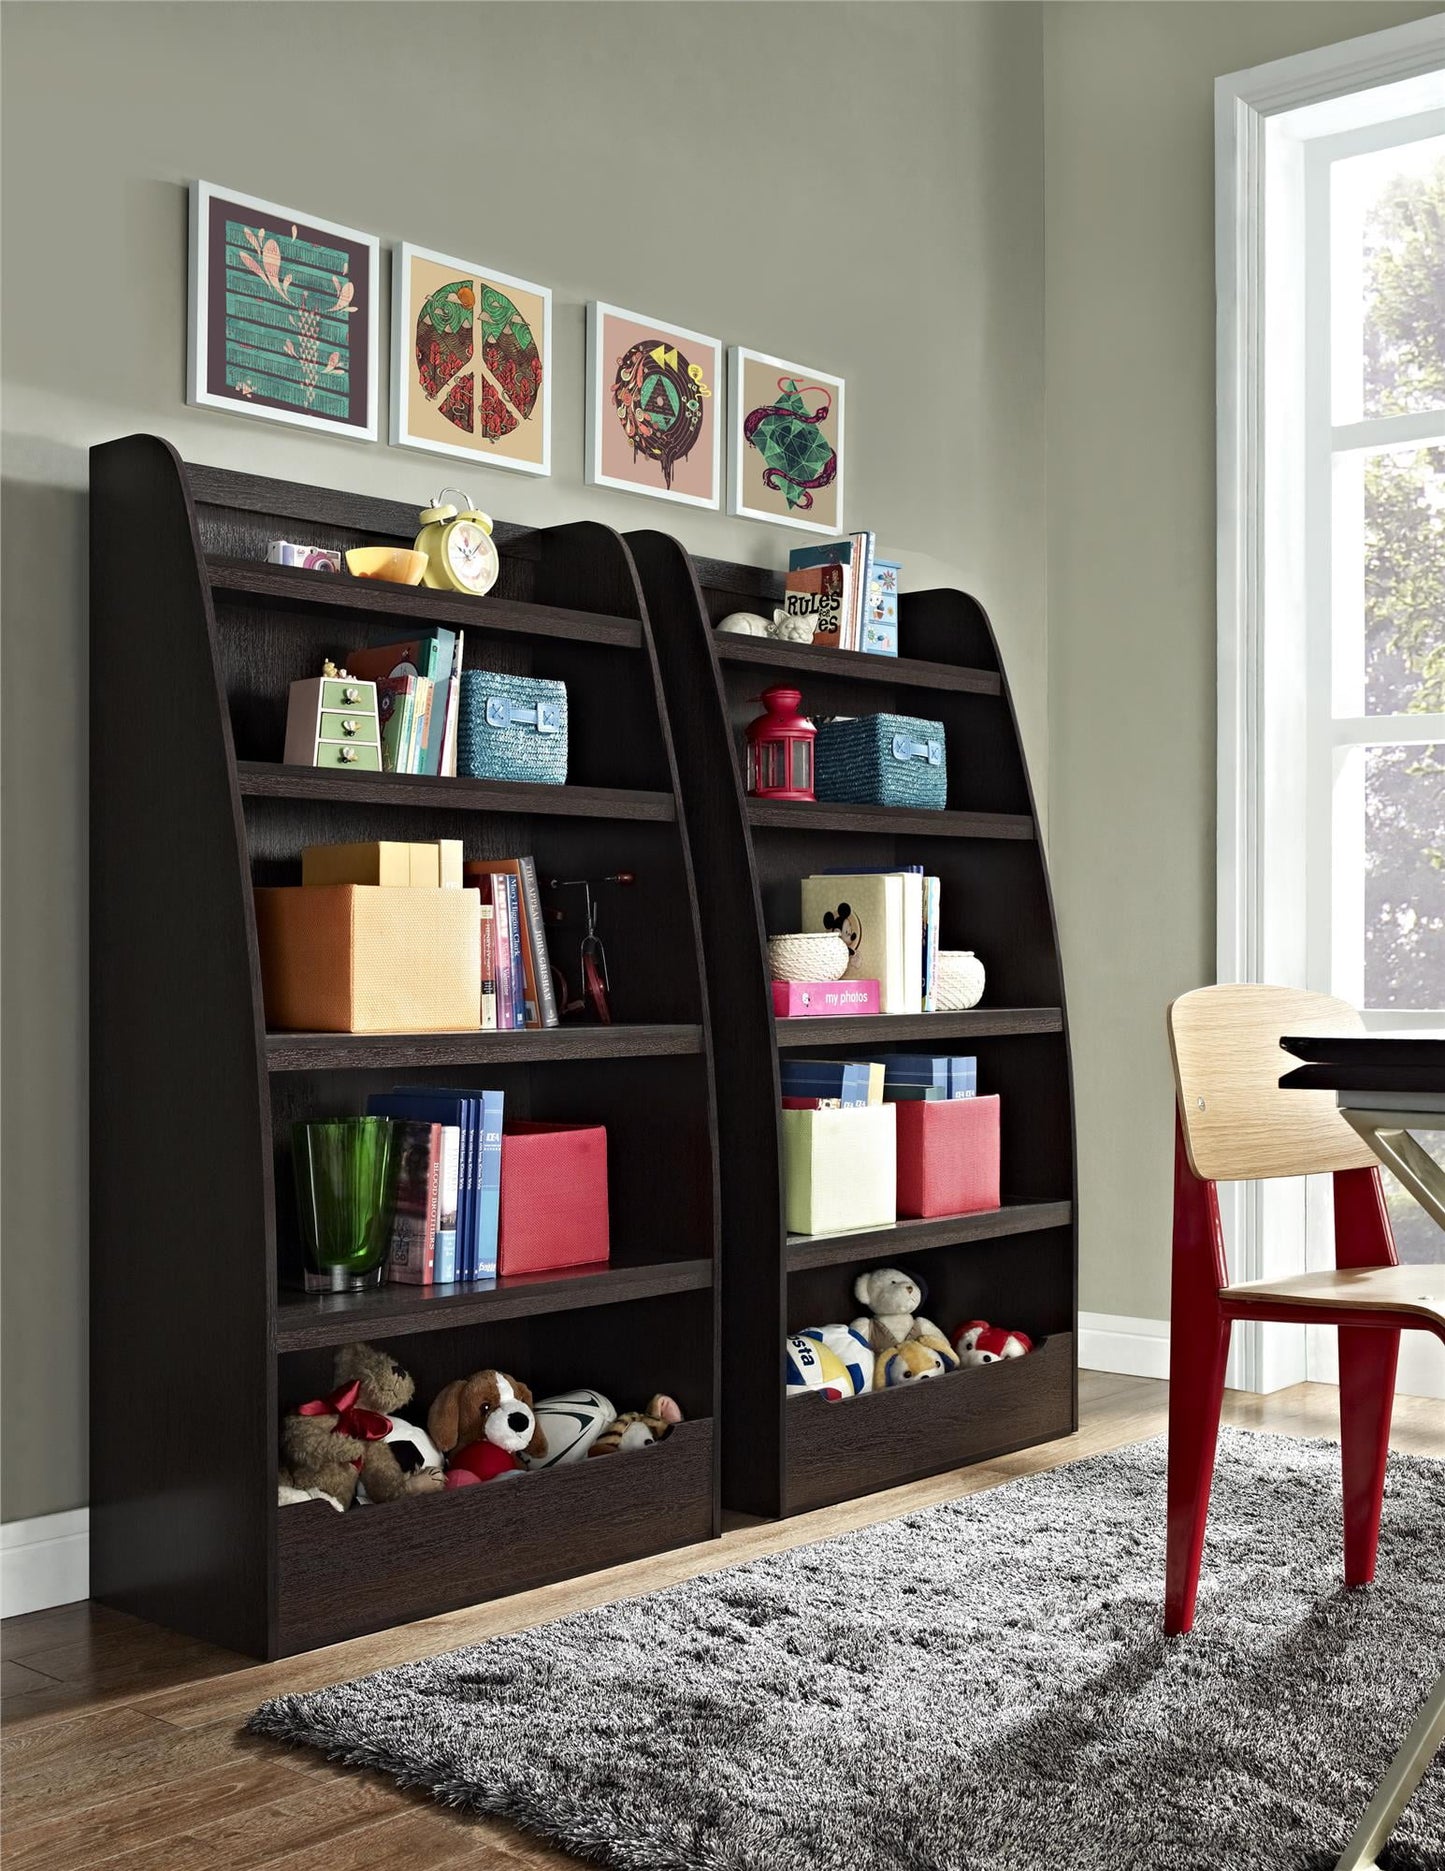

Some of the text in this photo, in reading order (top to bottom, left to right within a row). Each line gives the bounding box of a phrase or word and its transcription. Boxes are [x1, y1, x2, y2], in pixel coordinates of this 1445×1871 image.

[525, 864, 533, 883] THE
[528, 887, 539, 921] APPEAL
[534, 930, 544, 954] JOHN
[538, 957, 552, 1000] GRISHAM
[825, 990, 868, 1006] my photos
